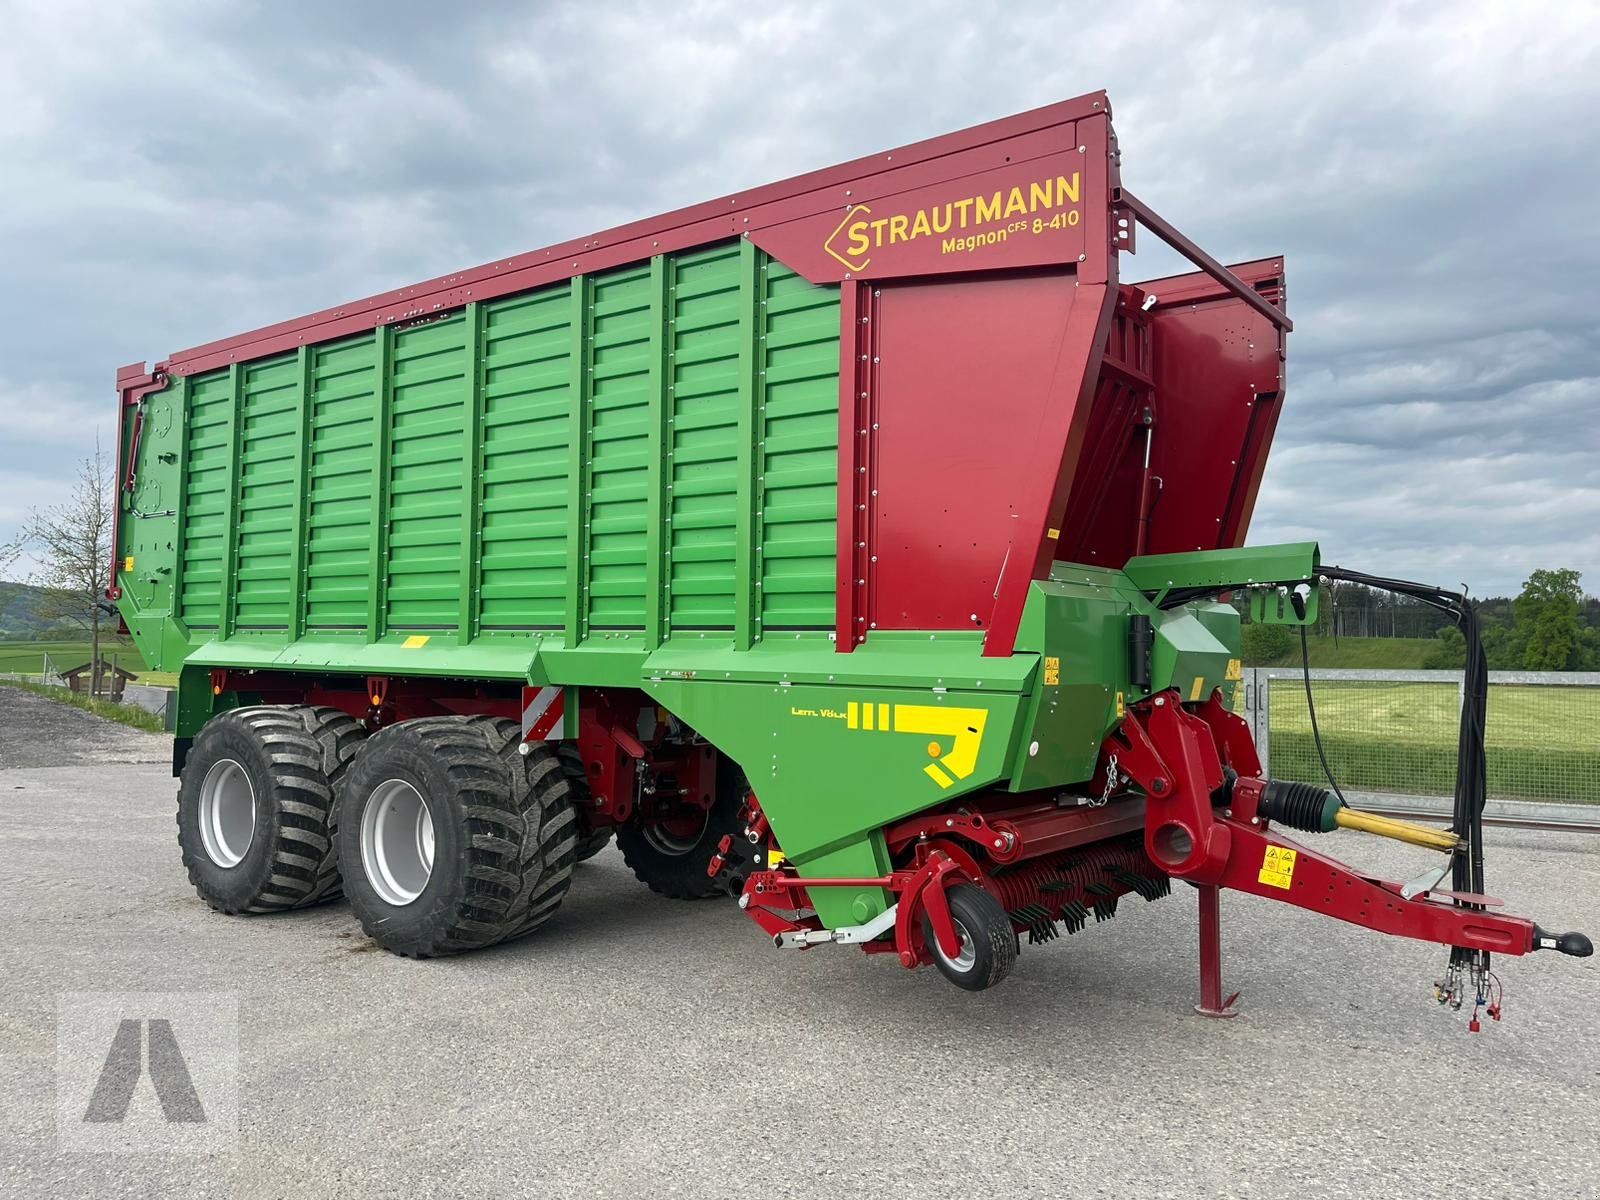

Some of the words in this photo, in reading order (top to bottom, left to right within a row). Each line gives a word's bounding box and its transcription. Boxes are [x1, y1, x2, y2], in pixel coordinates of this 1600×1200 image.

[846, 171, 1081, 257] STRAUTMANN
[941, 231, 1007, 255] Magnon
[1032, 209, 1080, 235] 8-410
